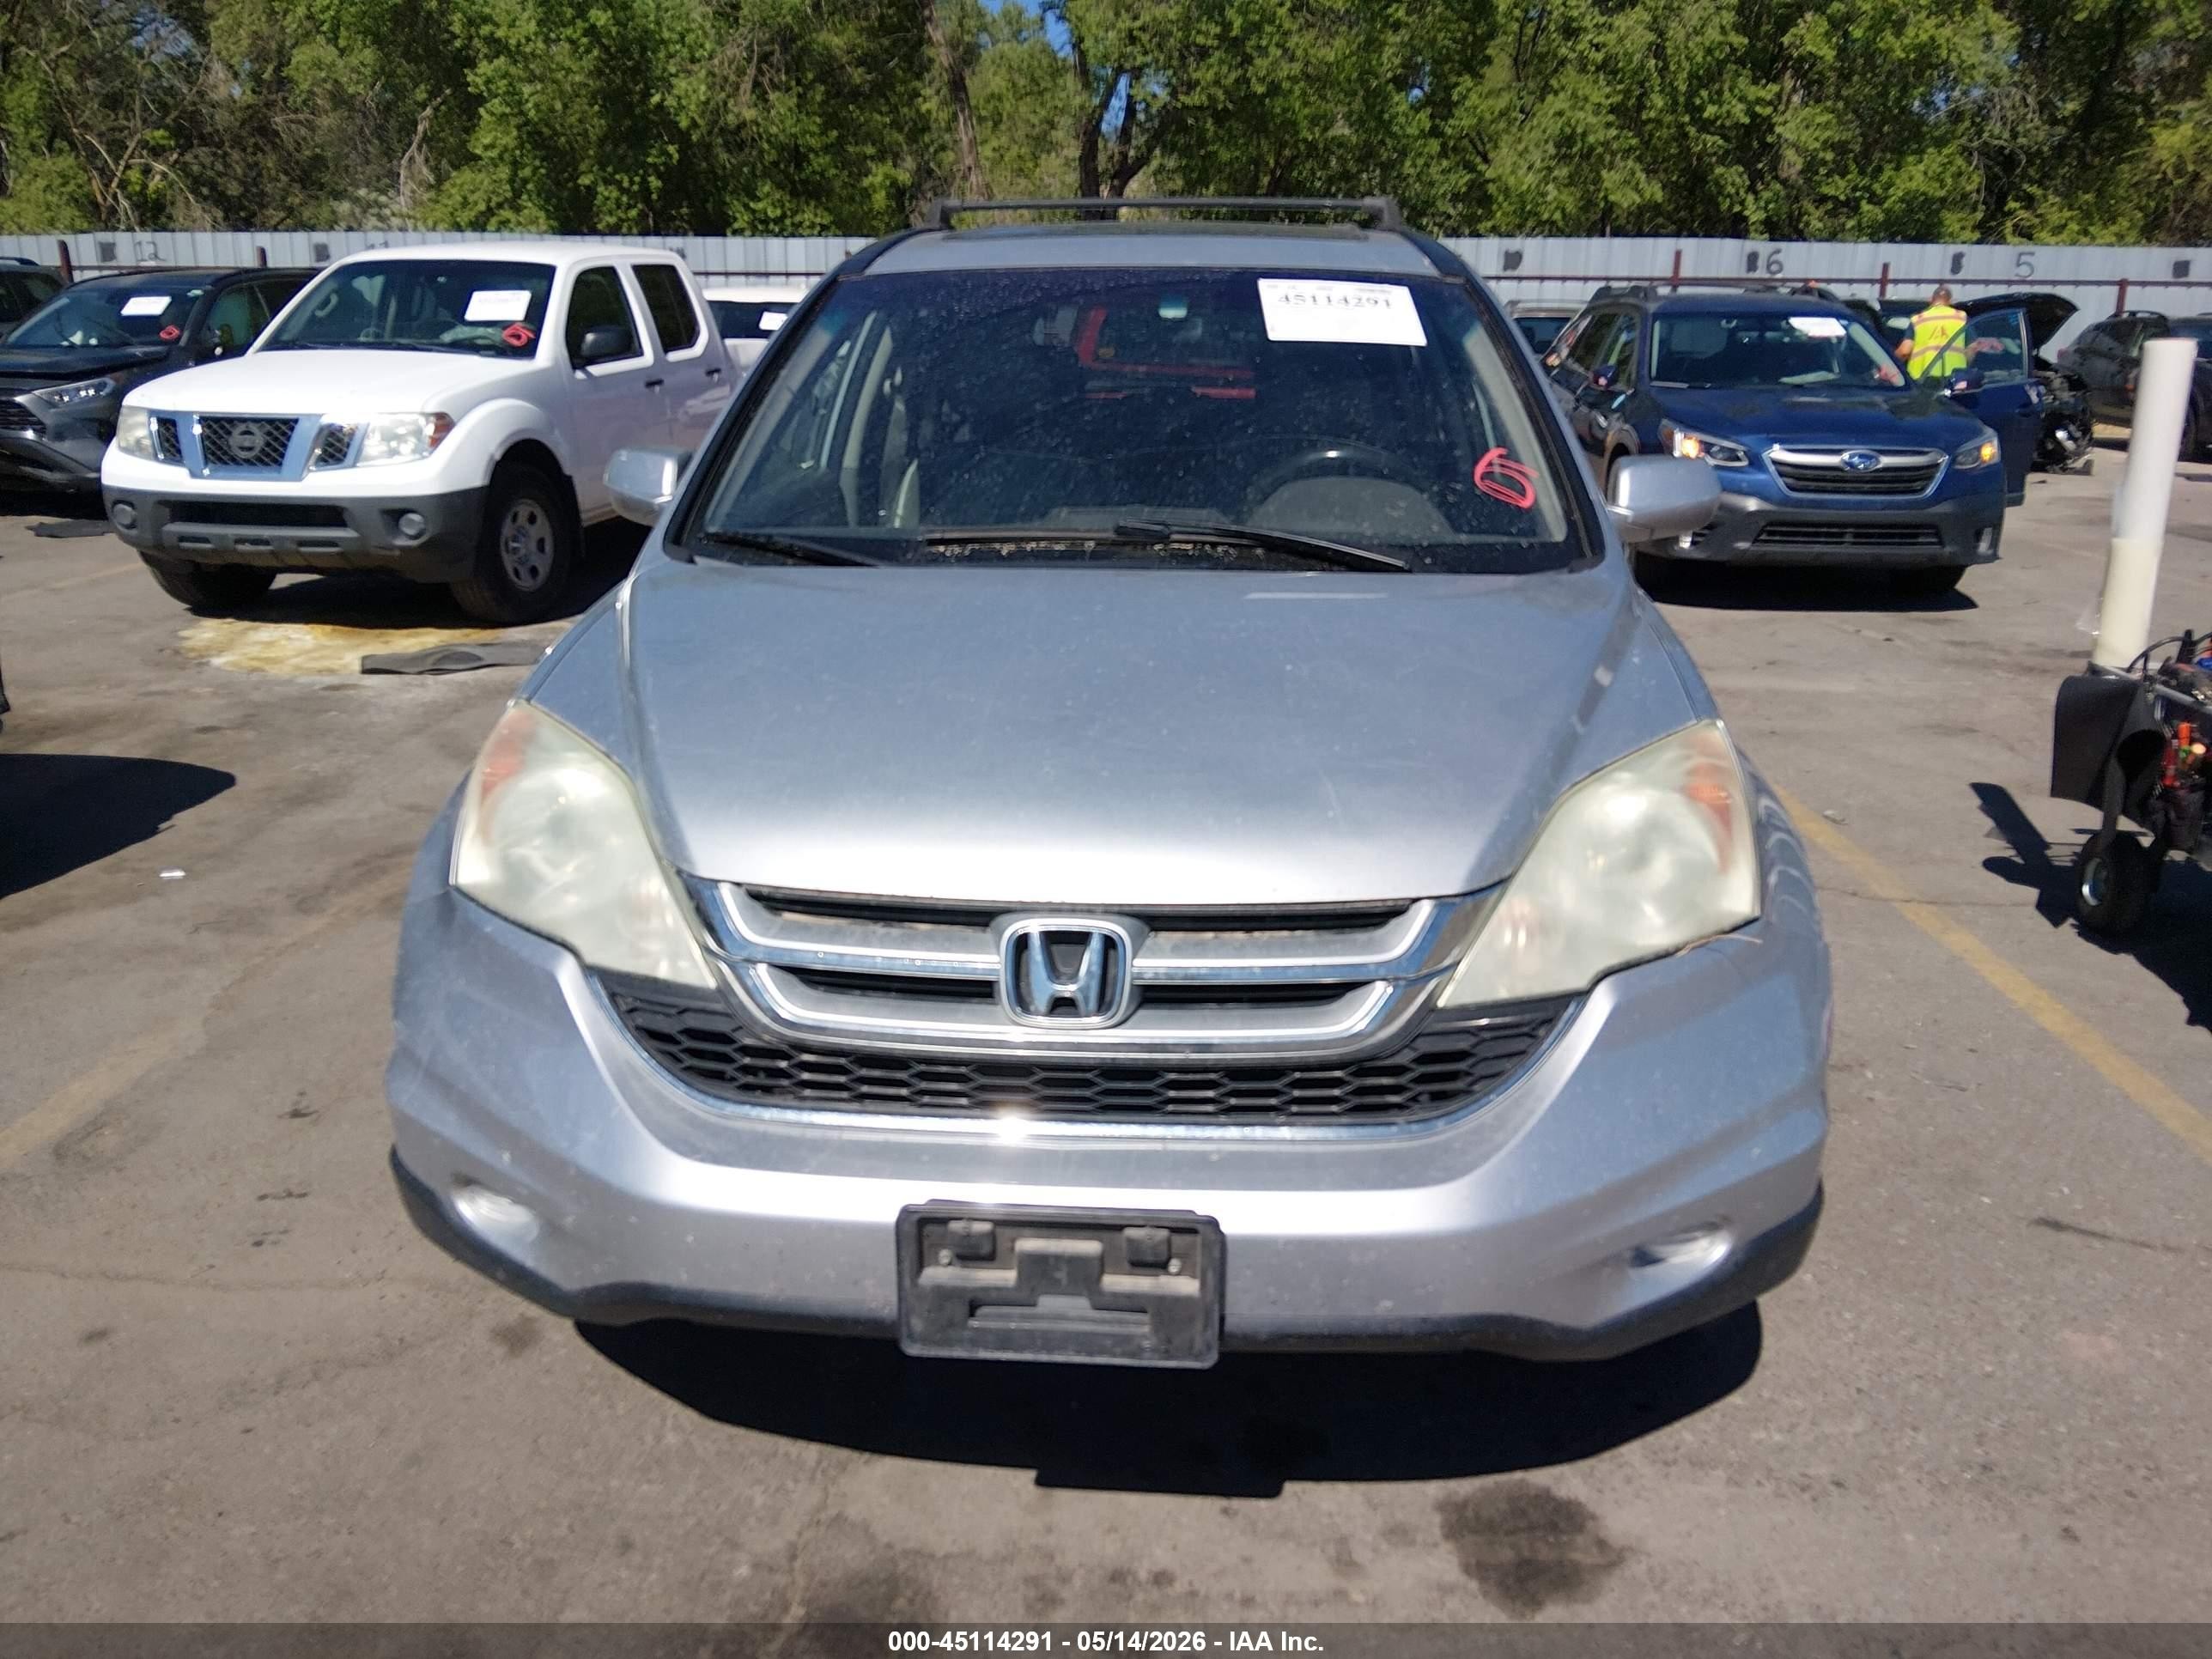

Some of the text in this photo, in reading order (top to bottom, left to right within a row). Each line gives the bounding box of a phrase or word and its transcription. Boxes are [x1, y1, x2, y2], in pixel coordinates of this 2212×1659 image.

[1766, 247, 1784, 275] 6
[2014, 252, 2036, 278] 5
[1277, 294, 1394, 310] 45114291
